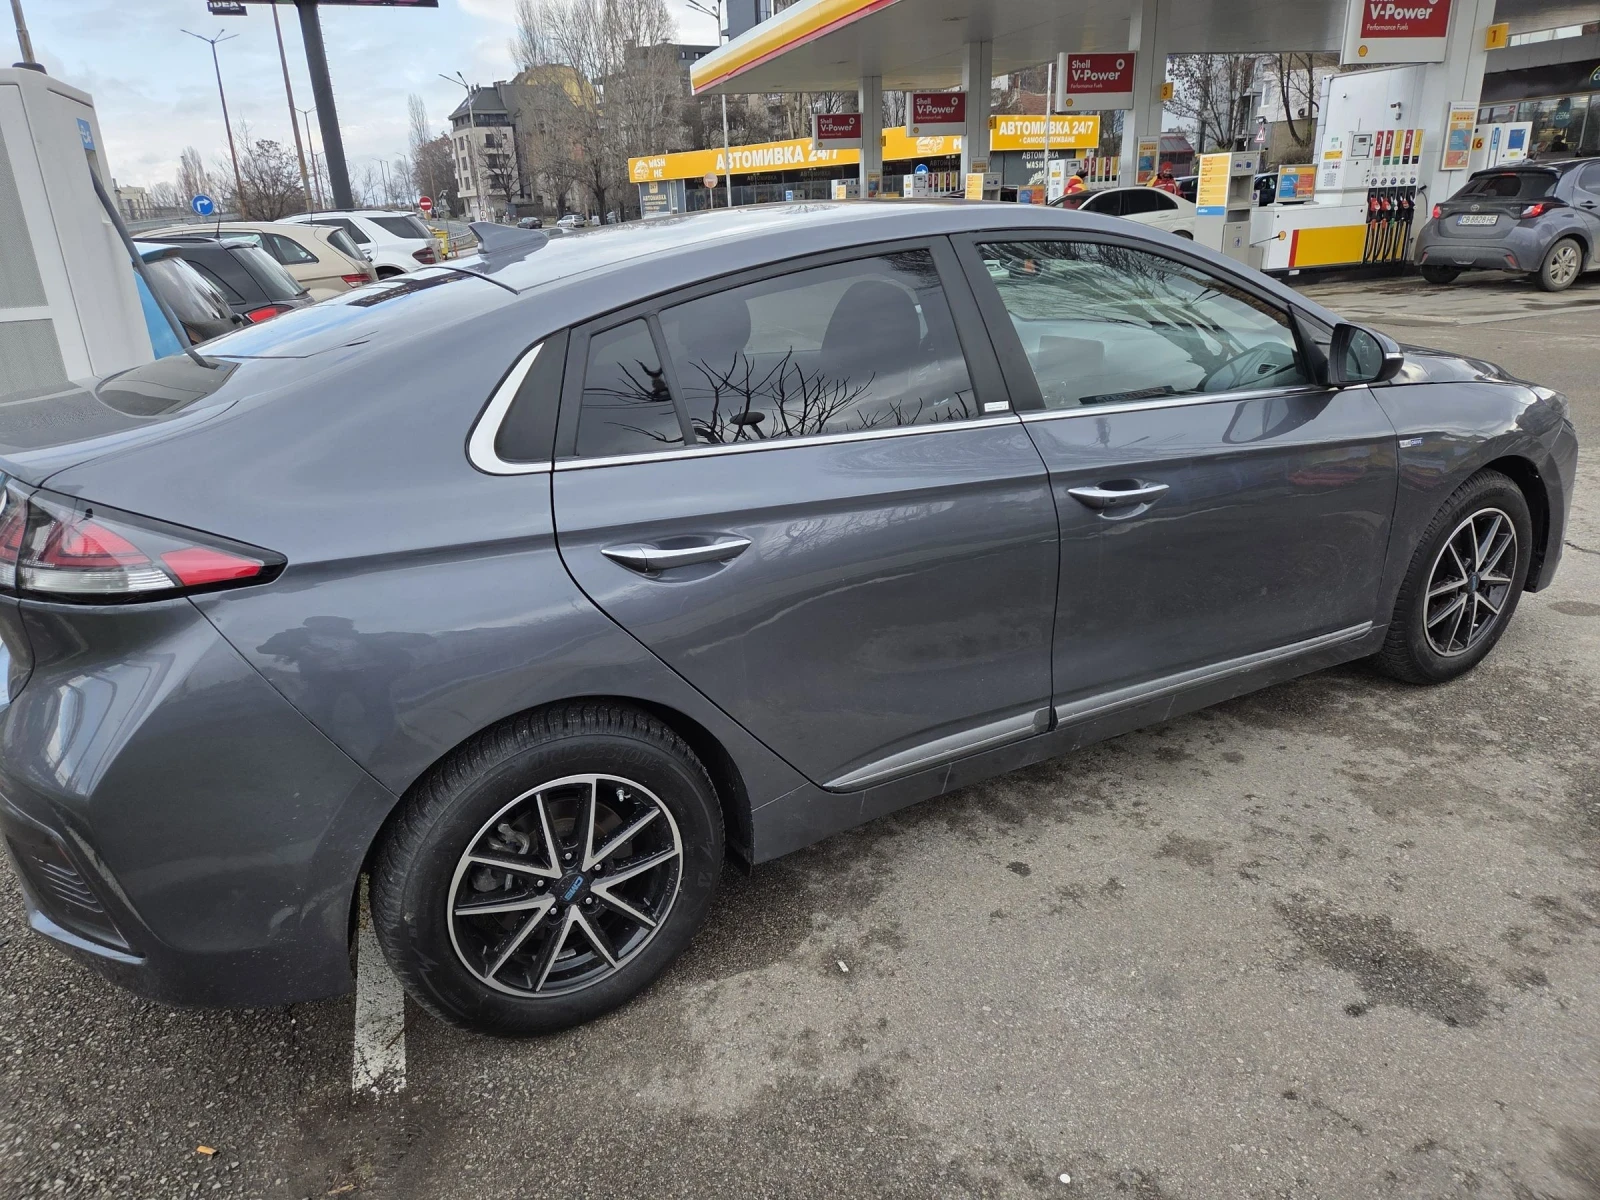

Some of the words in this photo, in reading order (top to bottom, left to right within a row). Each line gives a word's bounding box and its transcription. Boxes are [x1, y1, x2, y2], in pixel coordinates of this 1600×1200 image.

[1370, 3, 1433, 20] V-Power
[1366, 23, 1396, 31] Performance
[1397, 23, 1409, 31] Fuels
[1491, 30, 1497, 43] 1
[1072, 60, 1091, 69] Shell
[1072, 69, 1120, 81] V-Power
[1163, 86, 1168, 96] 3
[917, 106, 955, 115] V-Power
[820, 124, 853, 132] V-Power
[999, 121, 1070, 136] АВТОМИВКА
[1072, 121, 1094, 135] 24/7
[1022, 136, 1075, 144] САМООБЛУЖВАНЕ
[716, 145, 804, 171] АВТОМИВКА
[1021, 151, 1059, 160] АВТОМВКА
[648, 158, 666, 168] WASH
[1026, 161, 1044, 169] WASH
[653, 169, 663, 178] ME
